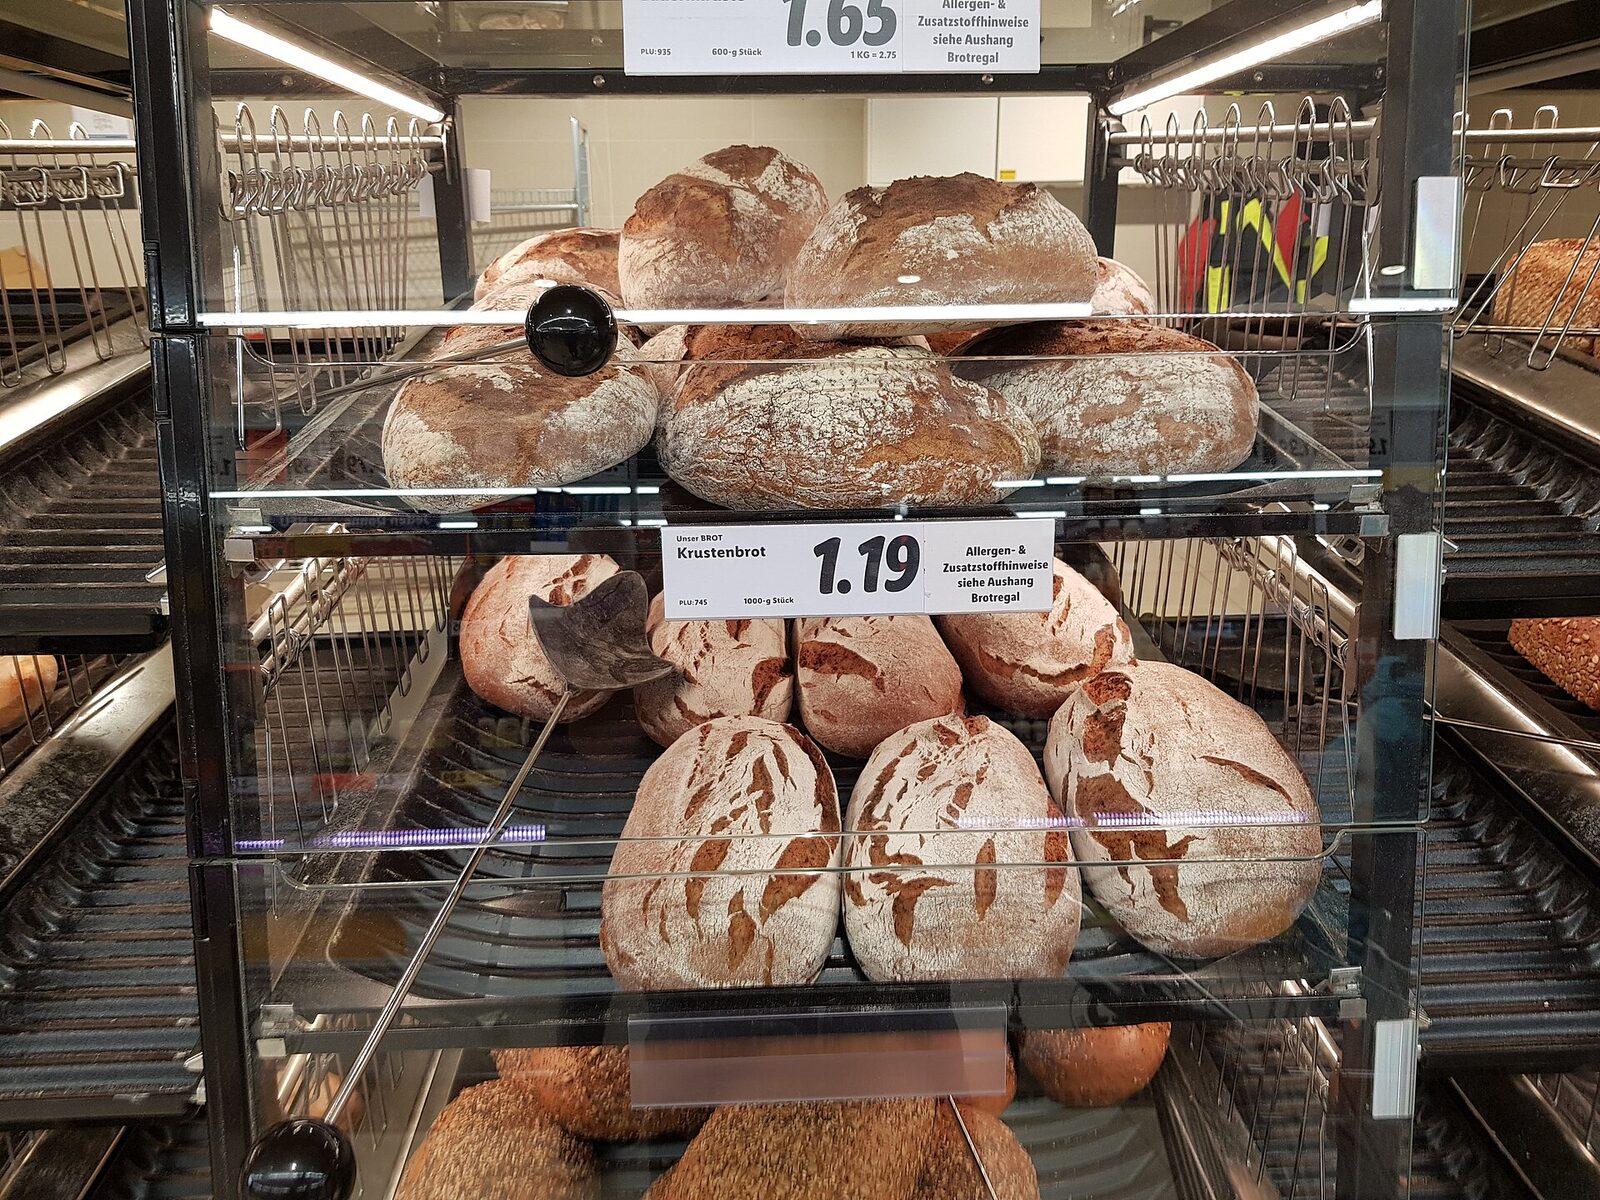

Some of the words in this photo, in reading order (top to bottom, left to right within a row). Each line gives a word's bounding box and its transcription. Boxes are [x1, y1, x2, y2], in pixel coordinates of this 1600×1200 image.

[942, 0, 995, 12] Allergen-
[997, 0, 1006, 9] &
[782, 0, 897, 47] 1.65
[918, 16, 1029, 28] Zusatzstoffhinweise
[932, 33, 962, 45] siehe
[964, 34, 1014, 48] Aushang
[711, 48, 737, 57] 600-g
[739, 48, 763, 57] Stück
[857, 51, 870, 59] KG
[879, 51, 897, 59] 2.75
[947, 51, 999, 66] Brotregal
[676, 535, 699, 543] Unser
[700, 534, 723, 542] BROT
[677, 546, 766, 559] Krustenbrot
[966, 546, 1016, 558] Allergen-
[1018, 546, 1026, 555] &
[813, 534, 920, 595] 1.19
[942, 560, 1049, 573] Zusatzstoffhinweise
[957, 577, 986, 588] siehe
[987, 577, 1034, 588] Aushang
[743, 597, 771, 606] 1000-g
[773, 596, 794, 604] Stück
[971, 592, 1020, 604] Brotregal
